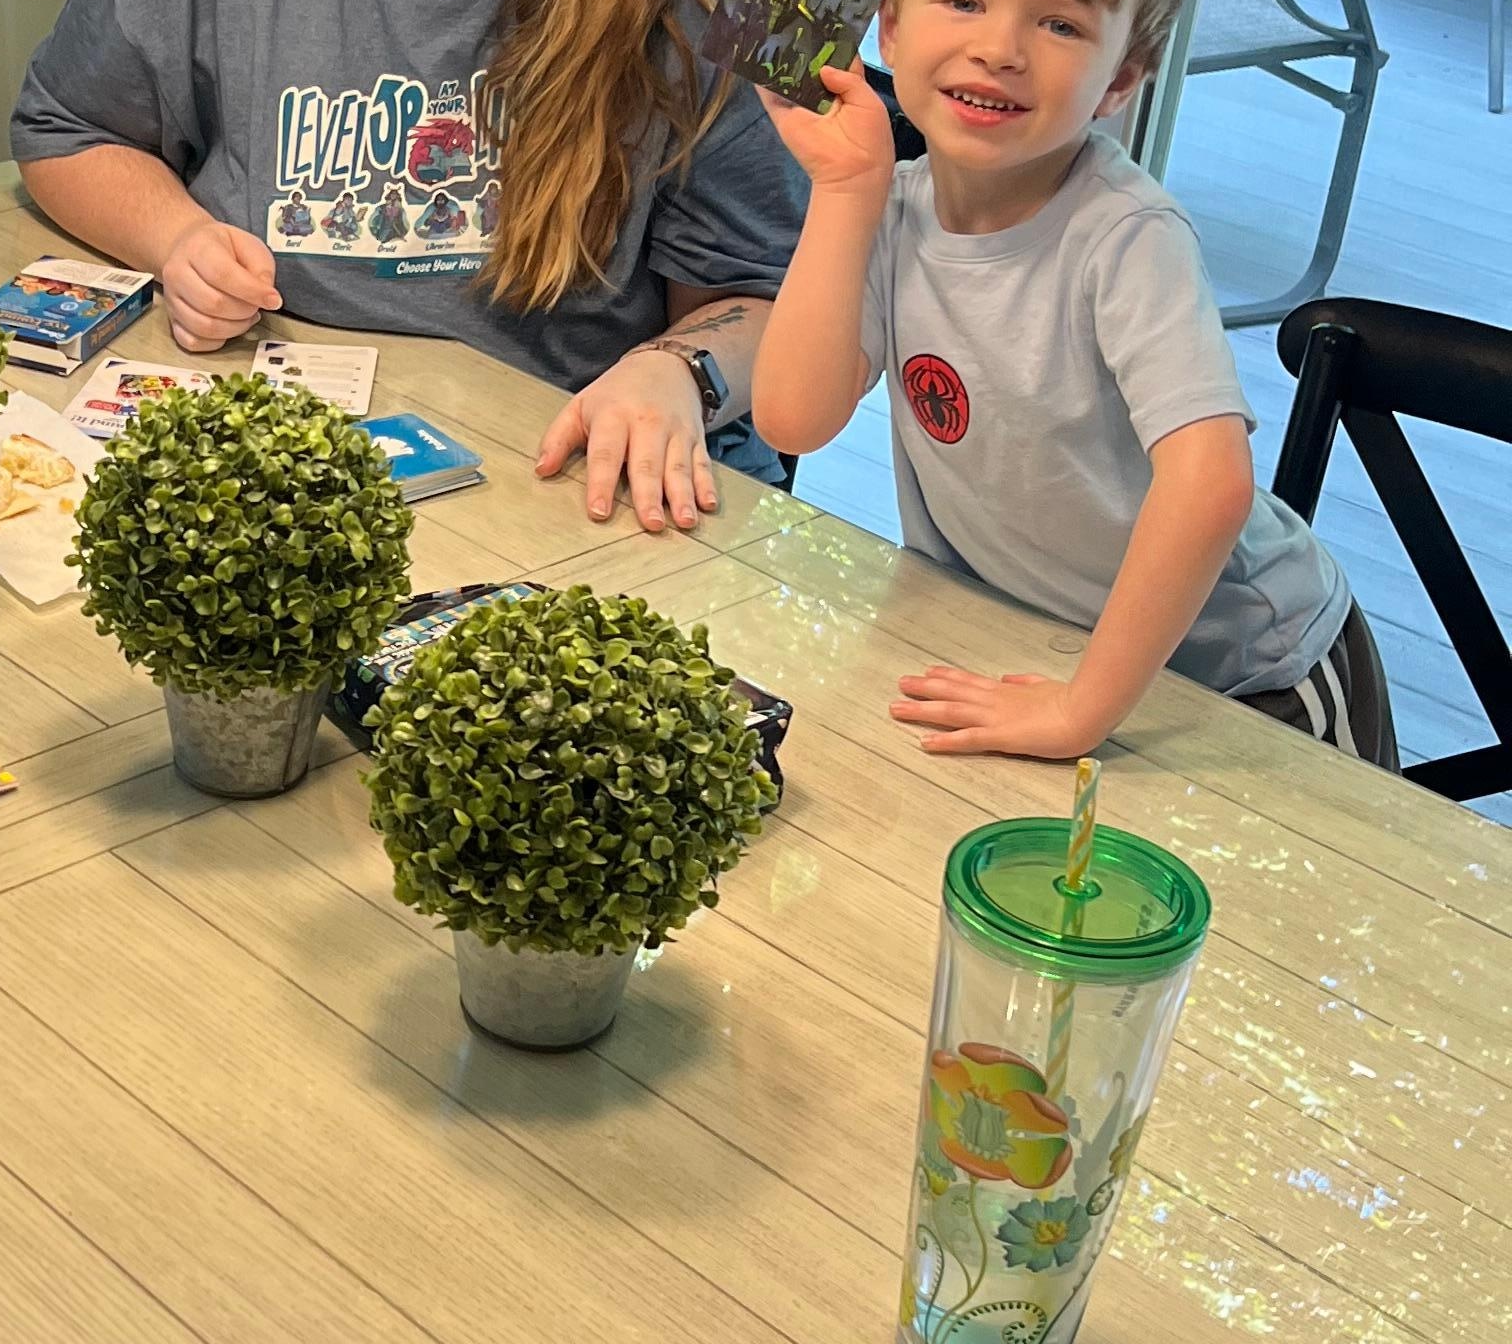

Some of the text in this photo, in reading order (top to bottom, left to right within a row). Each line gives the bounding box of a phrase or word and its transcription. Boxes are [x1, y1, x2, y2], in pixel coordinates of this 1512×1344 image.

[439, 82, 457, 97] AT
[430, 97, 465, 115] YOUR
[280, 91, 369, 187] LEVEL
[396, 257, 482, 275] Choose Your Hero
